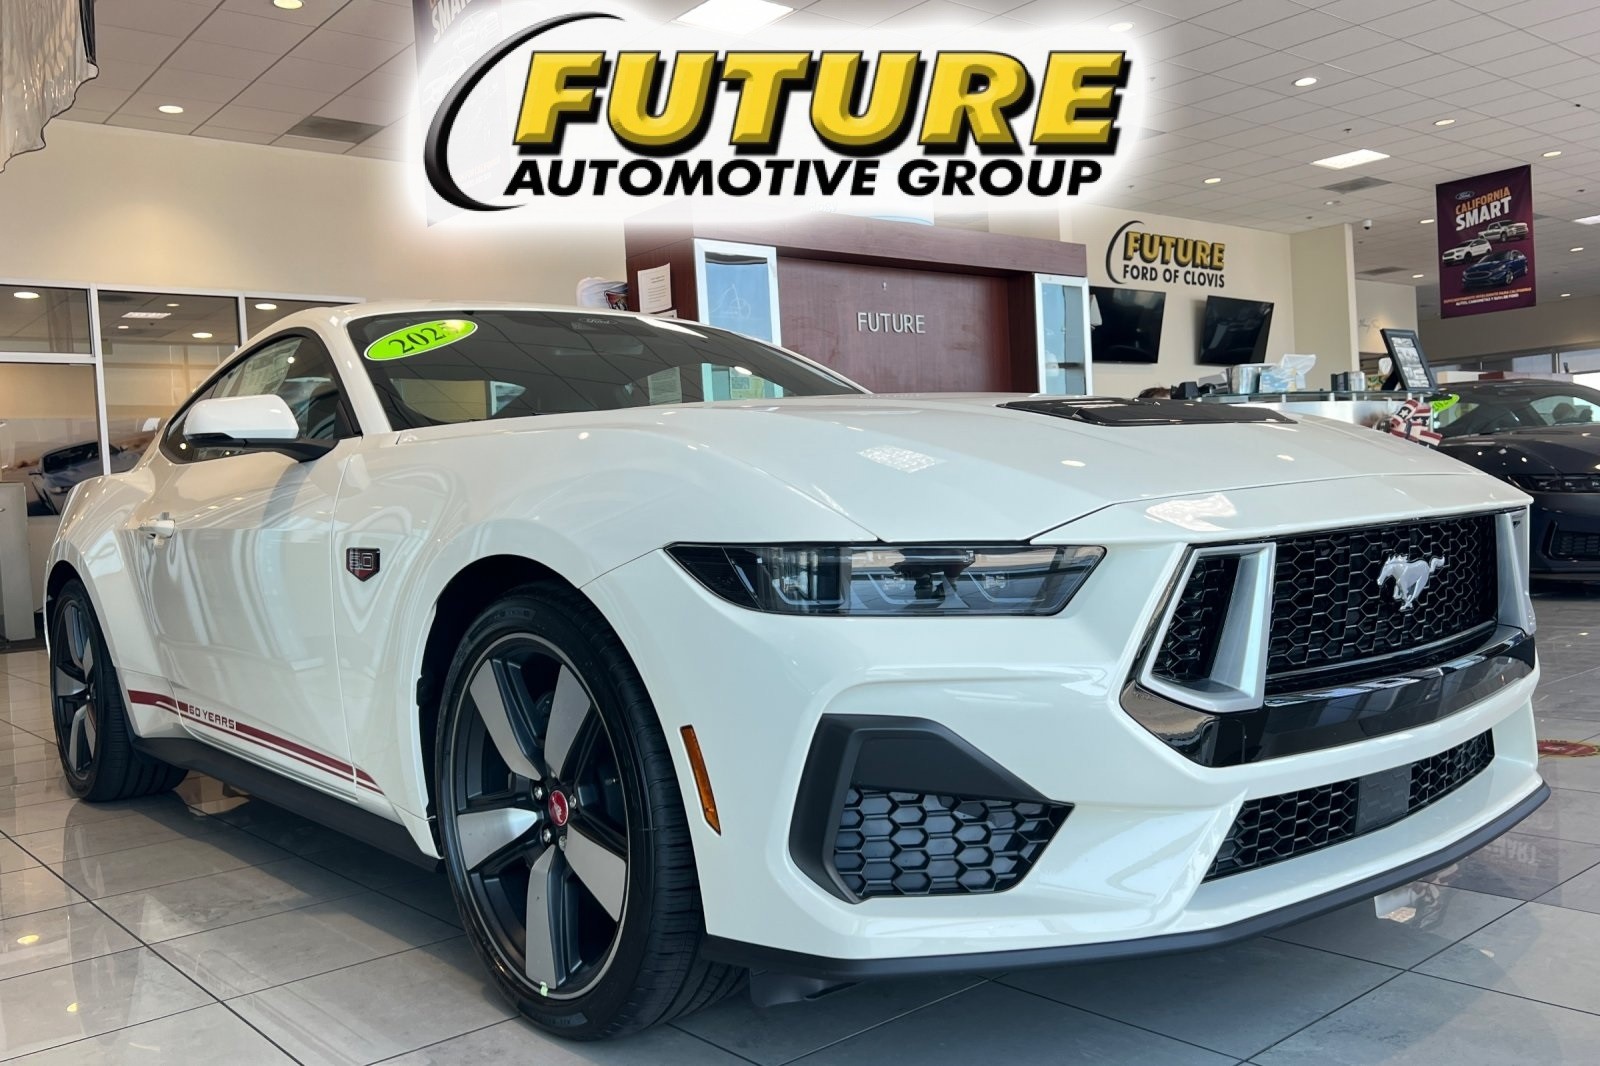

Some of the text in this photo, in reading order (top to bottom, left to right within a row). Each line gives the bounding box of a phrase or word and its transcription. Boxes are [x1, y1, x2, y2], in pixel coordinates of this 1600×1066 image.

[1456, 186, 1511, 215] CALIFORNIA
[1456, 196, 1512, 231] SMART
[1123, 231, 1225, 271] FUTURE
[1123, 264, 1225, 288] FORD OF CLOVIS
[856, 311, 926, 334] FUTURE
[189, 705, 235, 730] 60 YEARS
